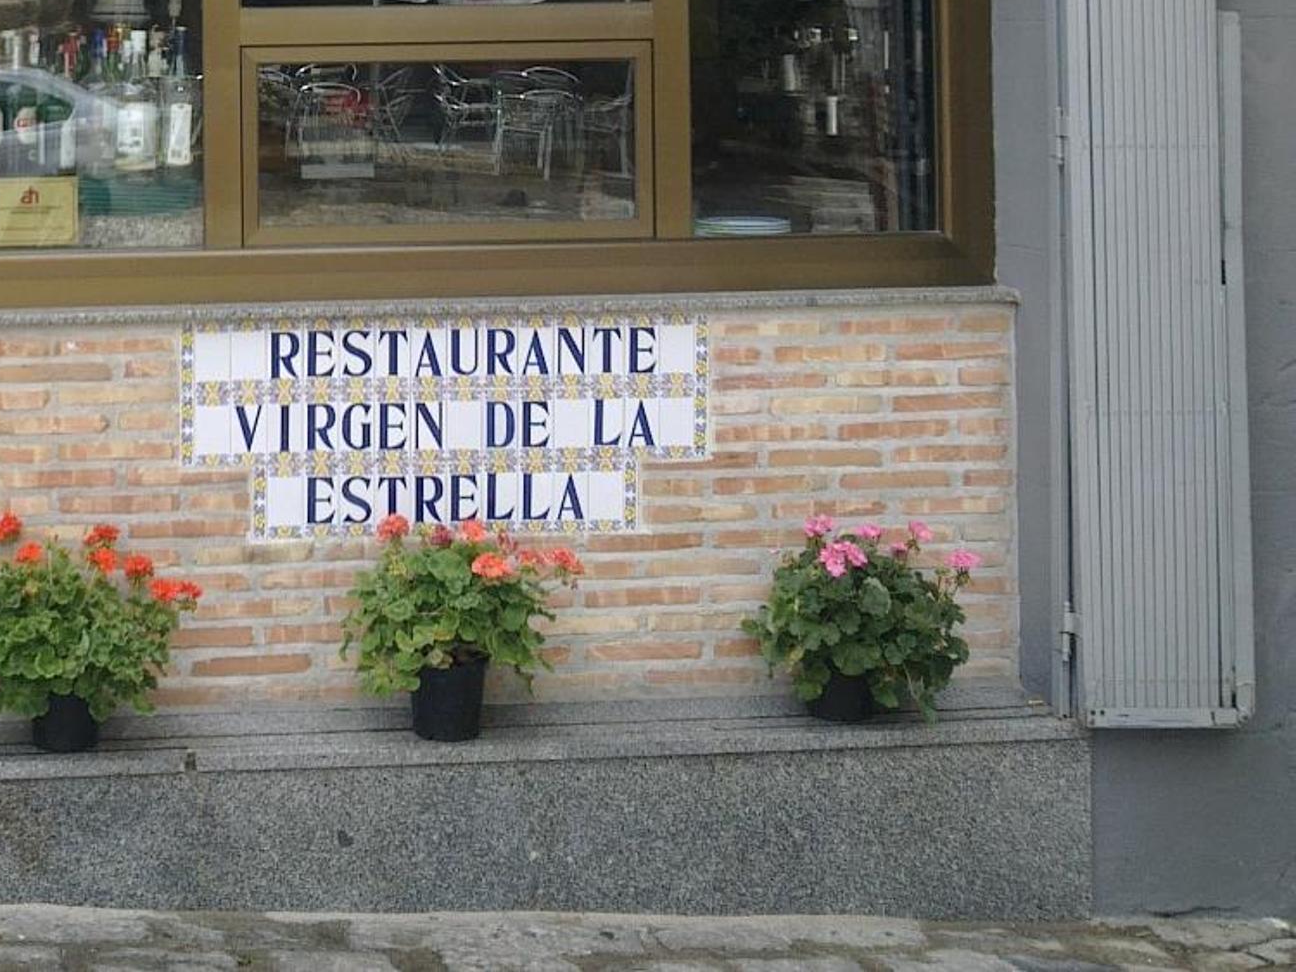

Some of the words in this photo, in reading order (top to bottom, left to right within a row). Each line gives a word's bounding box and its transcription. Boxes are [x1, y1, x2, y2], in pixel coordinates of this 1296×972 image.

[270, 328, 657, 379] RESTAURANTE
[235, 400, 444, 454] VIRGEN
[486, 400, 549, 448] DE
[593, 398, 656, 448] LA
[306, 472, 585, 525] ESTRELLA
